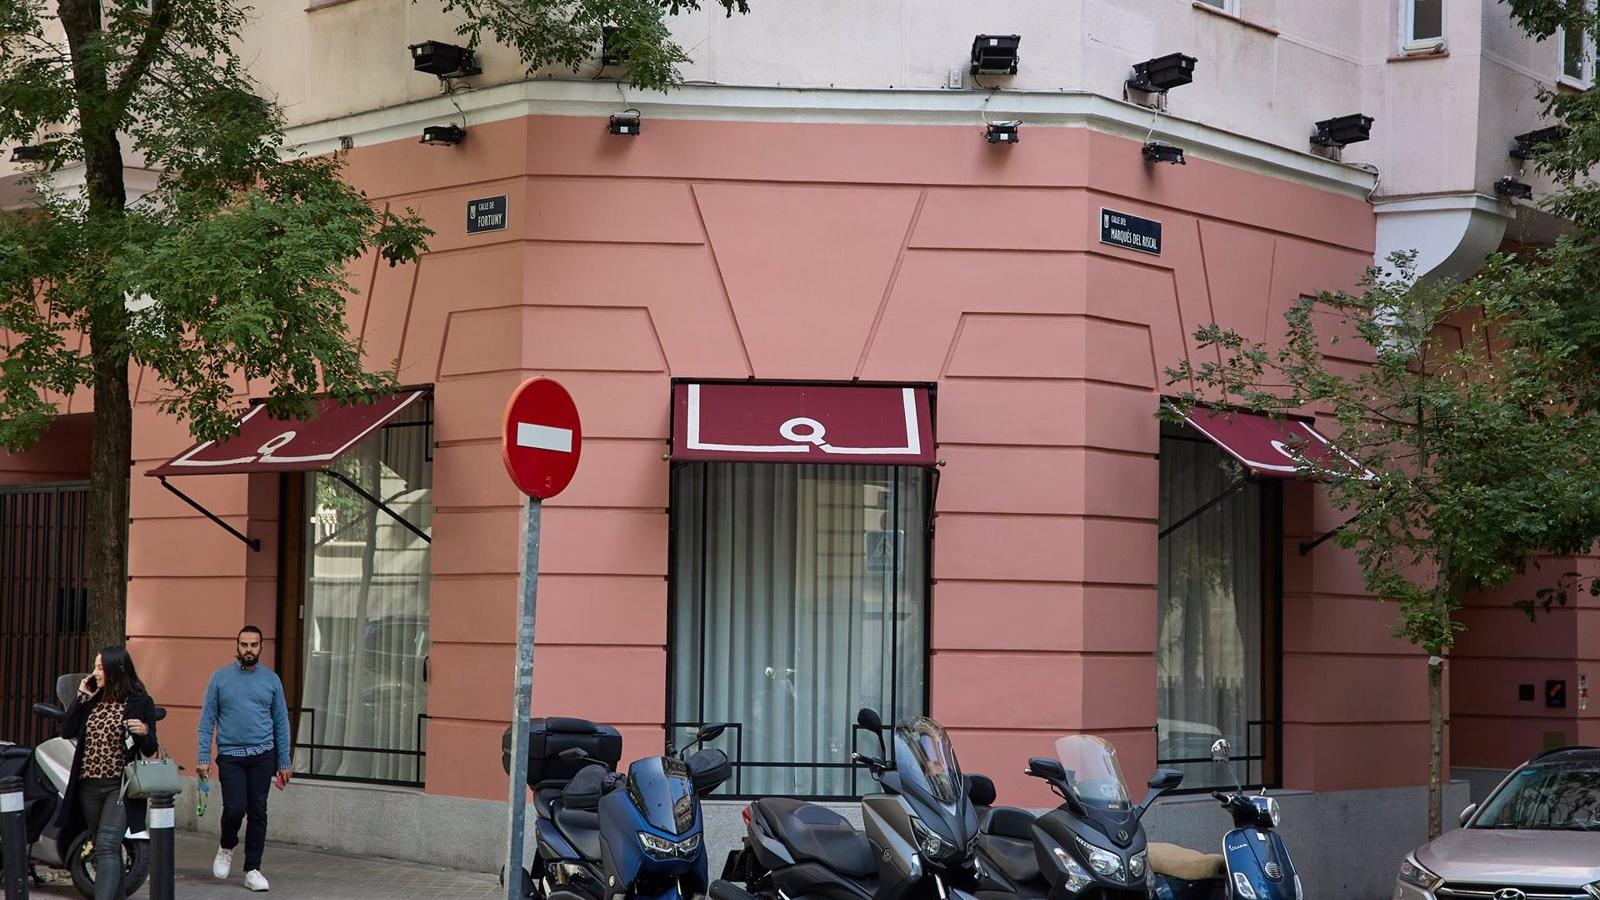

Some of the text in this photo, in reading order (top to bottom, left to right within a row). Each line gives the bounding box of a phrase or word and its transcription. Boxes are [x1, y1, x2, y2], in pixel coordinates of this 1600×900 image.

[478, 201, 495, 211] CALLE DE
[478, 213, 502, 227] FORTUNY
[1110, 215, 1120, 224] CALLE
[1110, 228, 1157, 250] MARQUÉS DEL RISCAL
[780, 417, 827, 446] Q
[257, 431, 297, 457] Q
